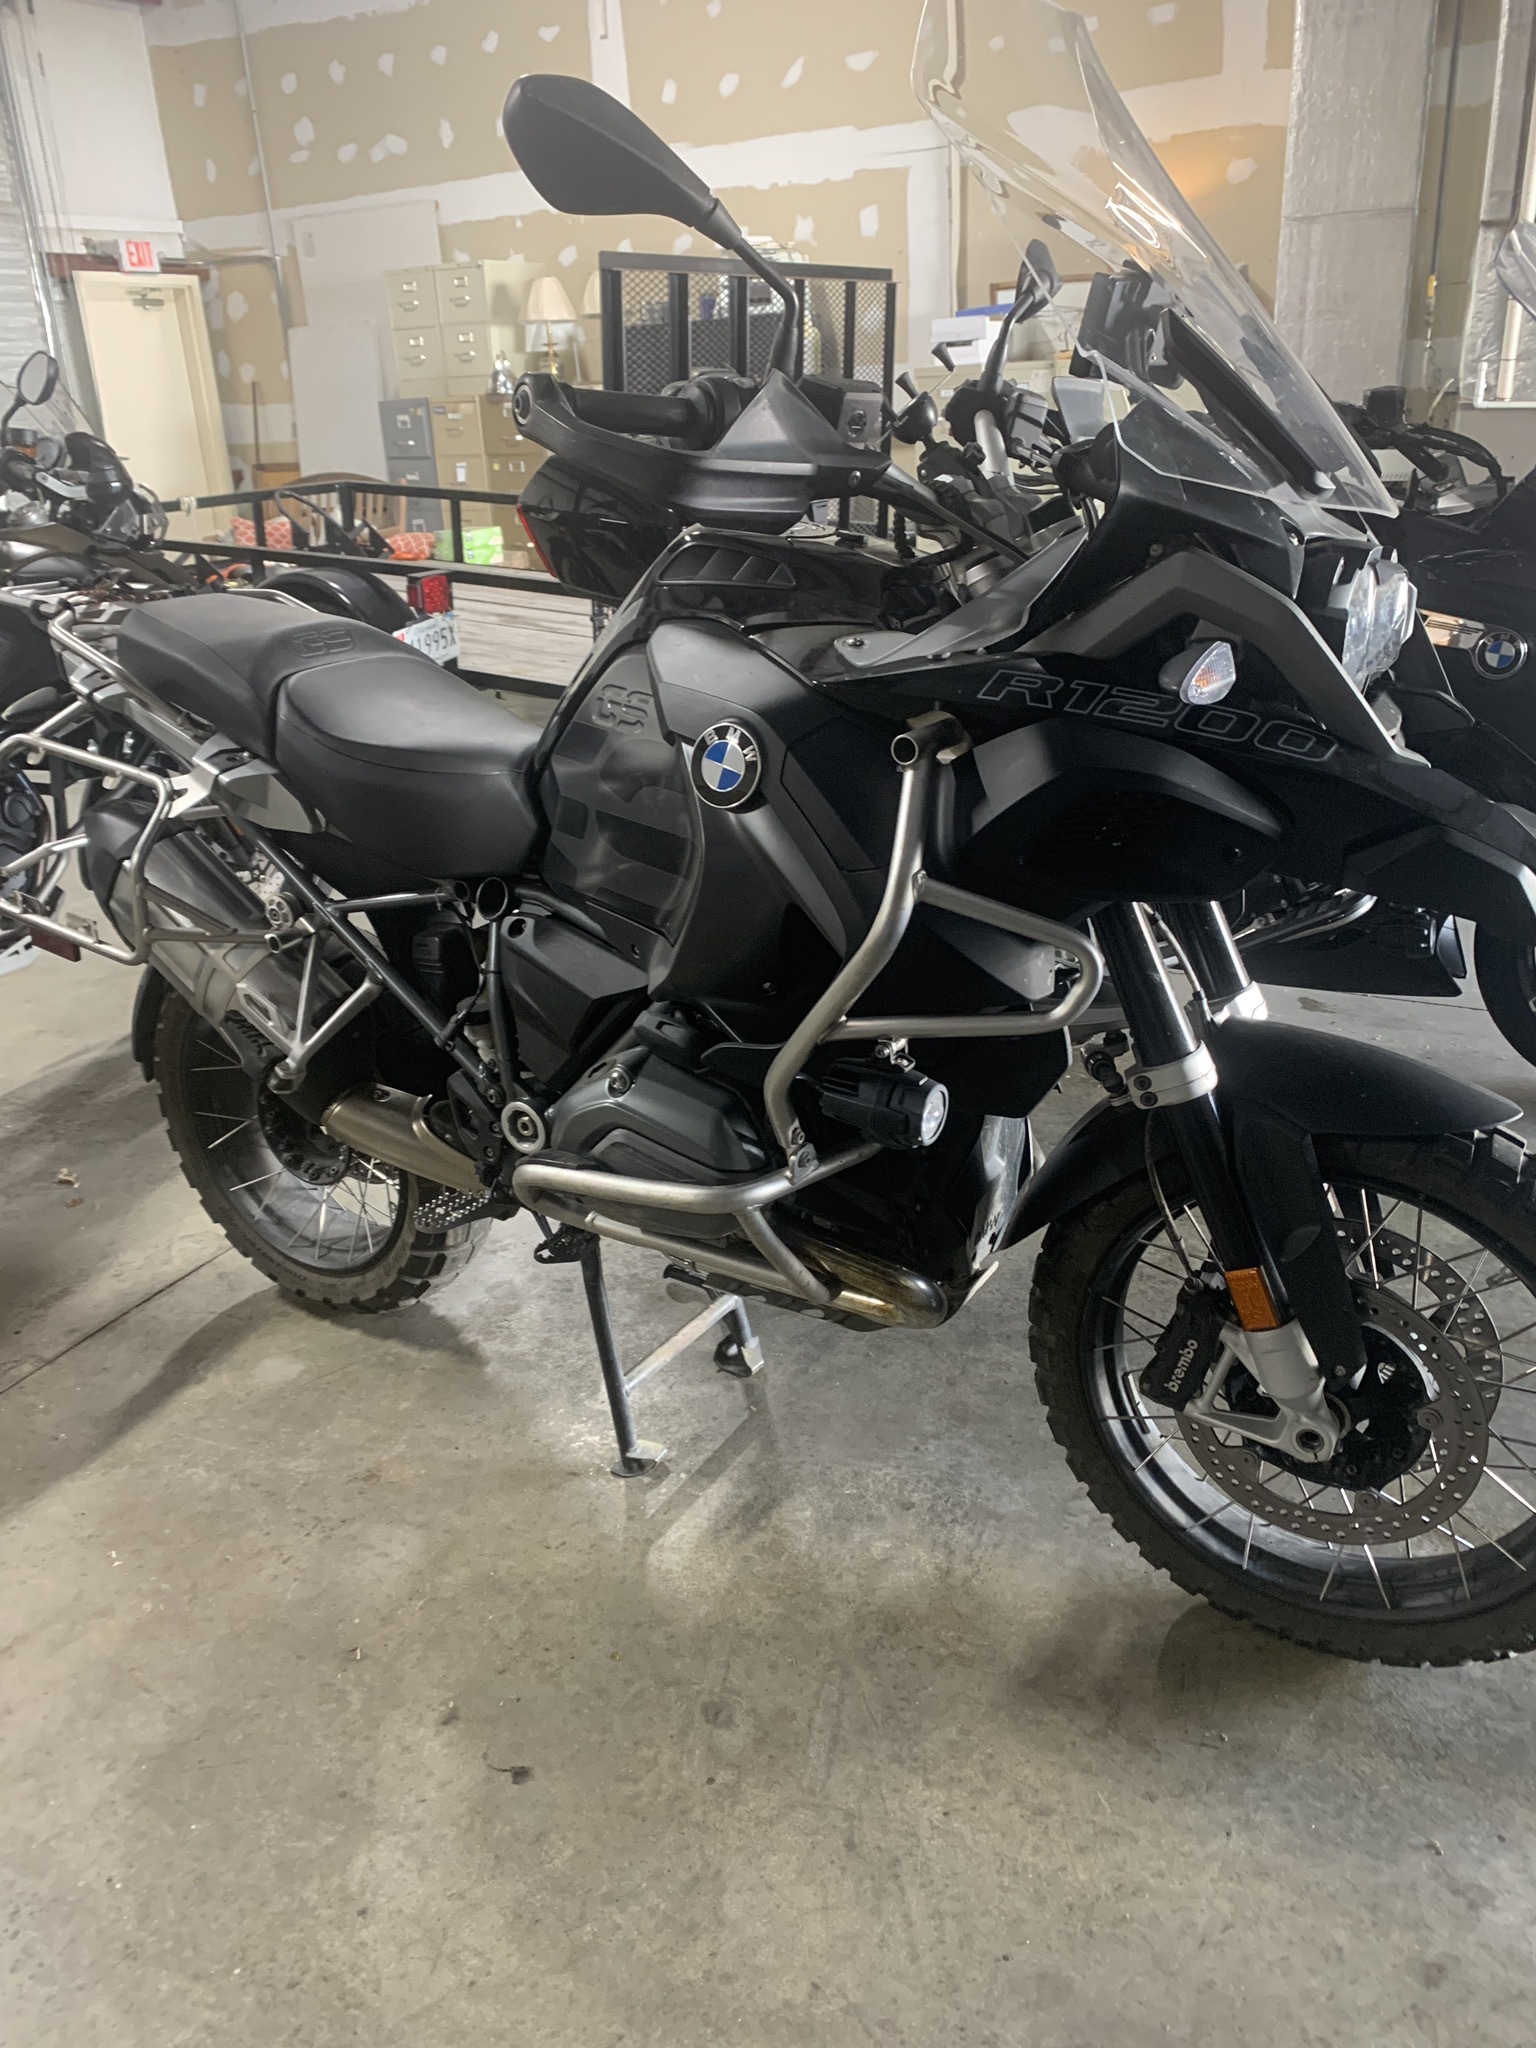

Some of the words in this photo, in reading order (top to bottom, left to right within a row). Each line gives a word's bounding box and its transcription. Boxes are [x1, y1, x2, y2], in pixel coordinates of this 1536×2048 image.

[125, 239, 154, 268] EXIT
[976, 669, 1338, 752] R1200
[703, 726, 758, 763] BMW
[1163, 1339, 1199, 1393] brembo
